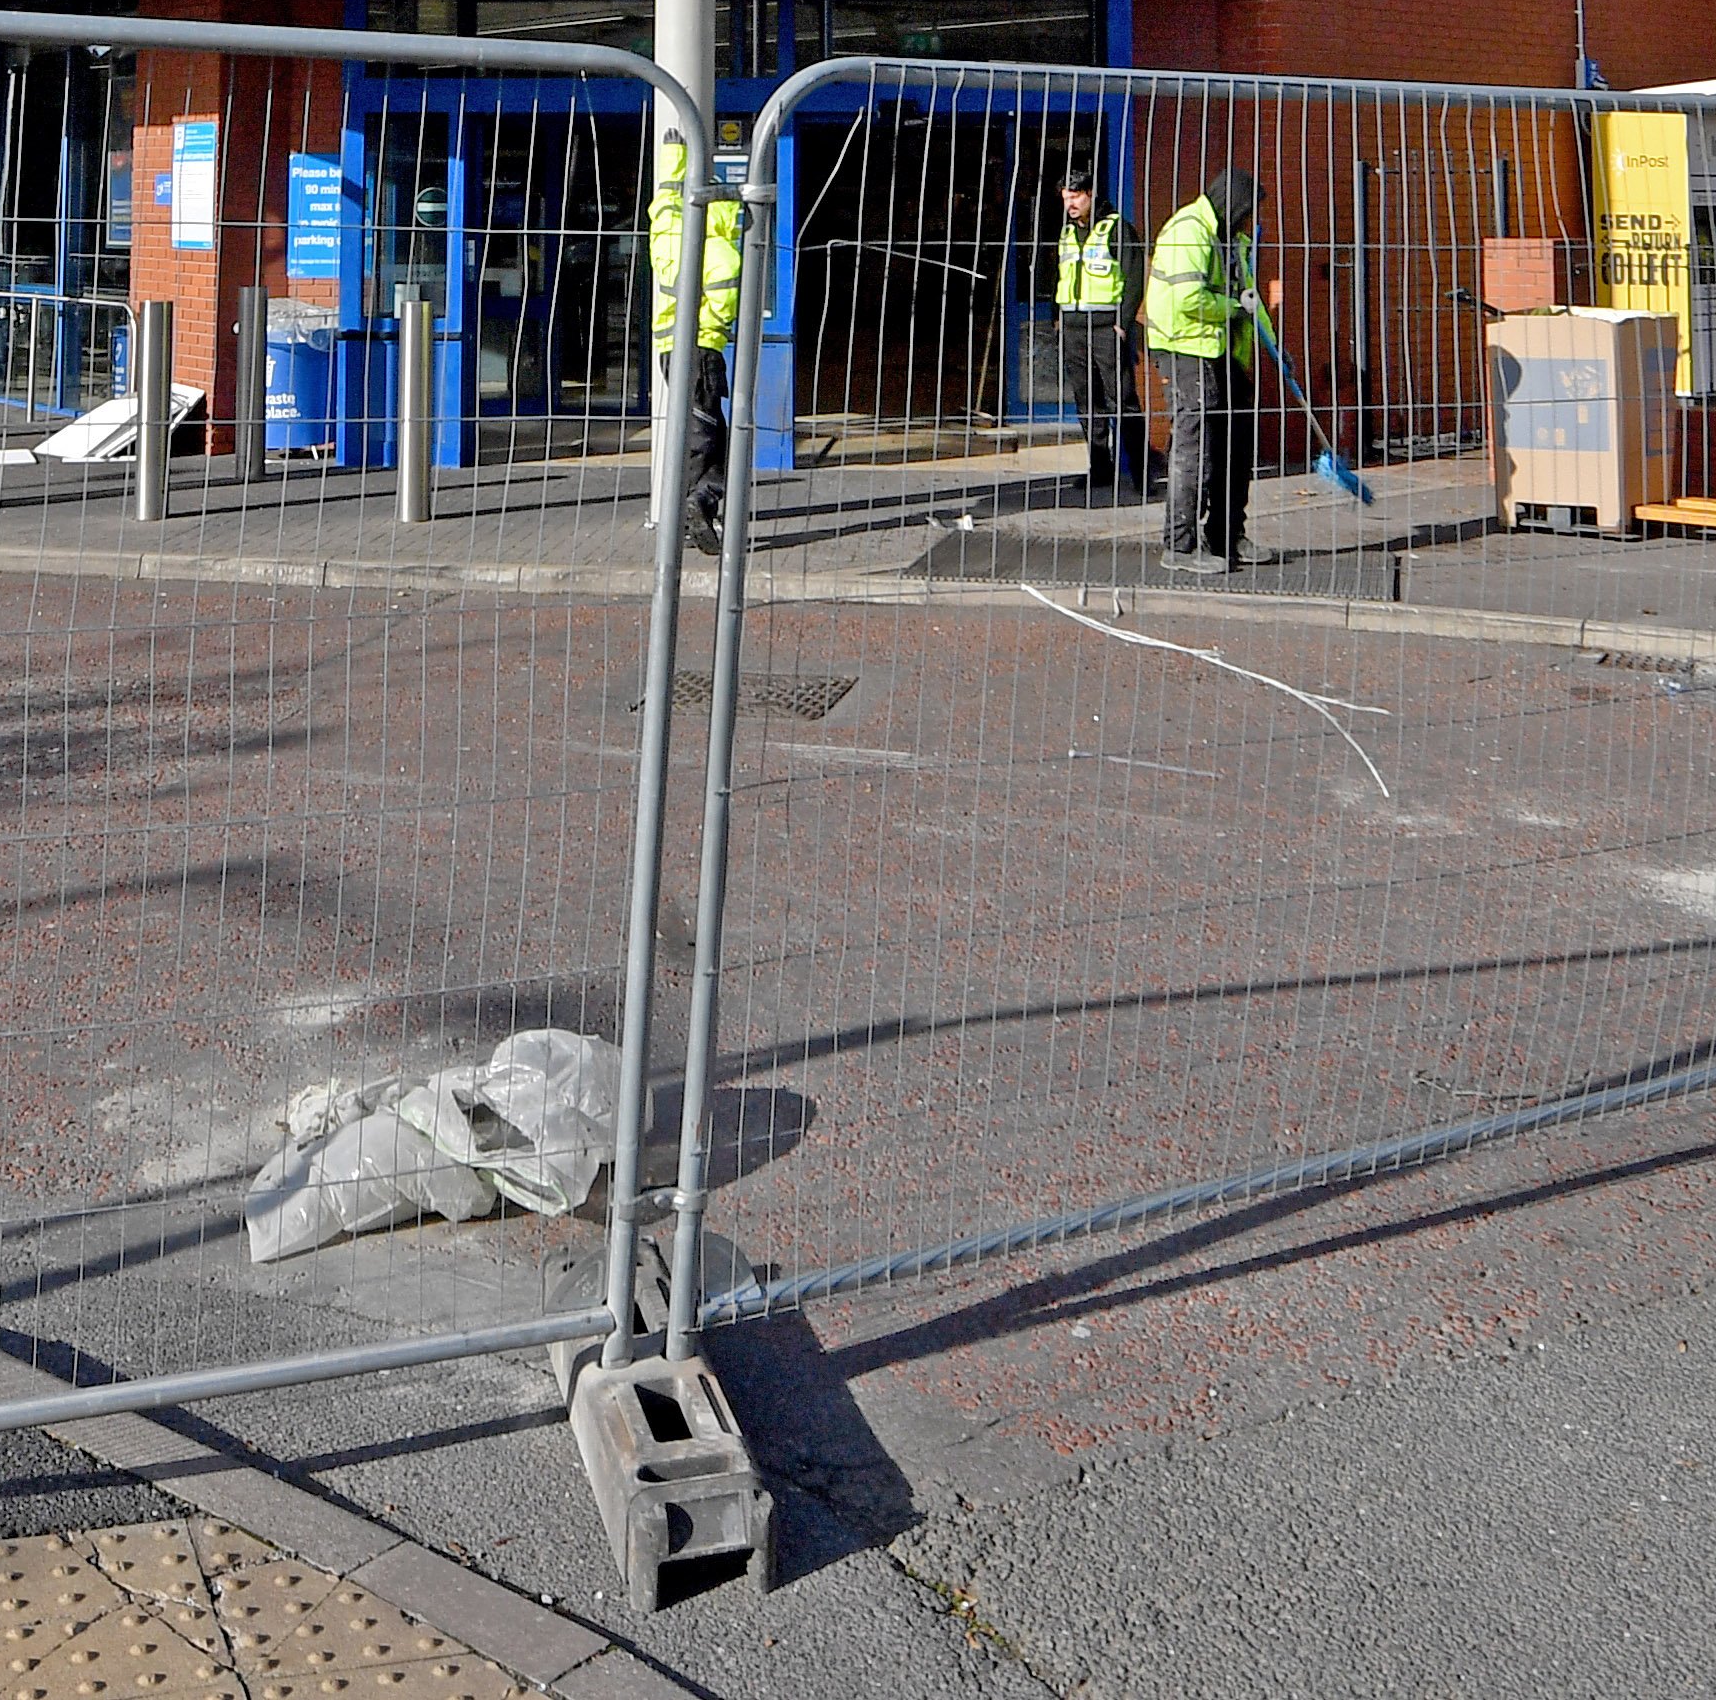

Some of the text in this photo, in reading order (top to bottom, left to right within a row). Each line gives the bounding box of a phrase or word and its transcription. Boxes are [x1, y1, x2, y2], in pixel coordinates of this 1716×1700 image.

[1626, 155, 1669, 168] InPost
[292, 167, 327, 178] Please
[305, 184, 318, 194] 90
[310, 203, 332, 211] max
[1601, 214, 1662, 231] SEND
[294, 235, 334, 247] parking
[1632, 232, 1681, 251] RETURN
[1601, 252, 1682, 286] COLLECT
